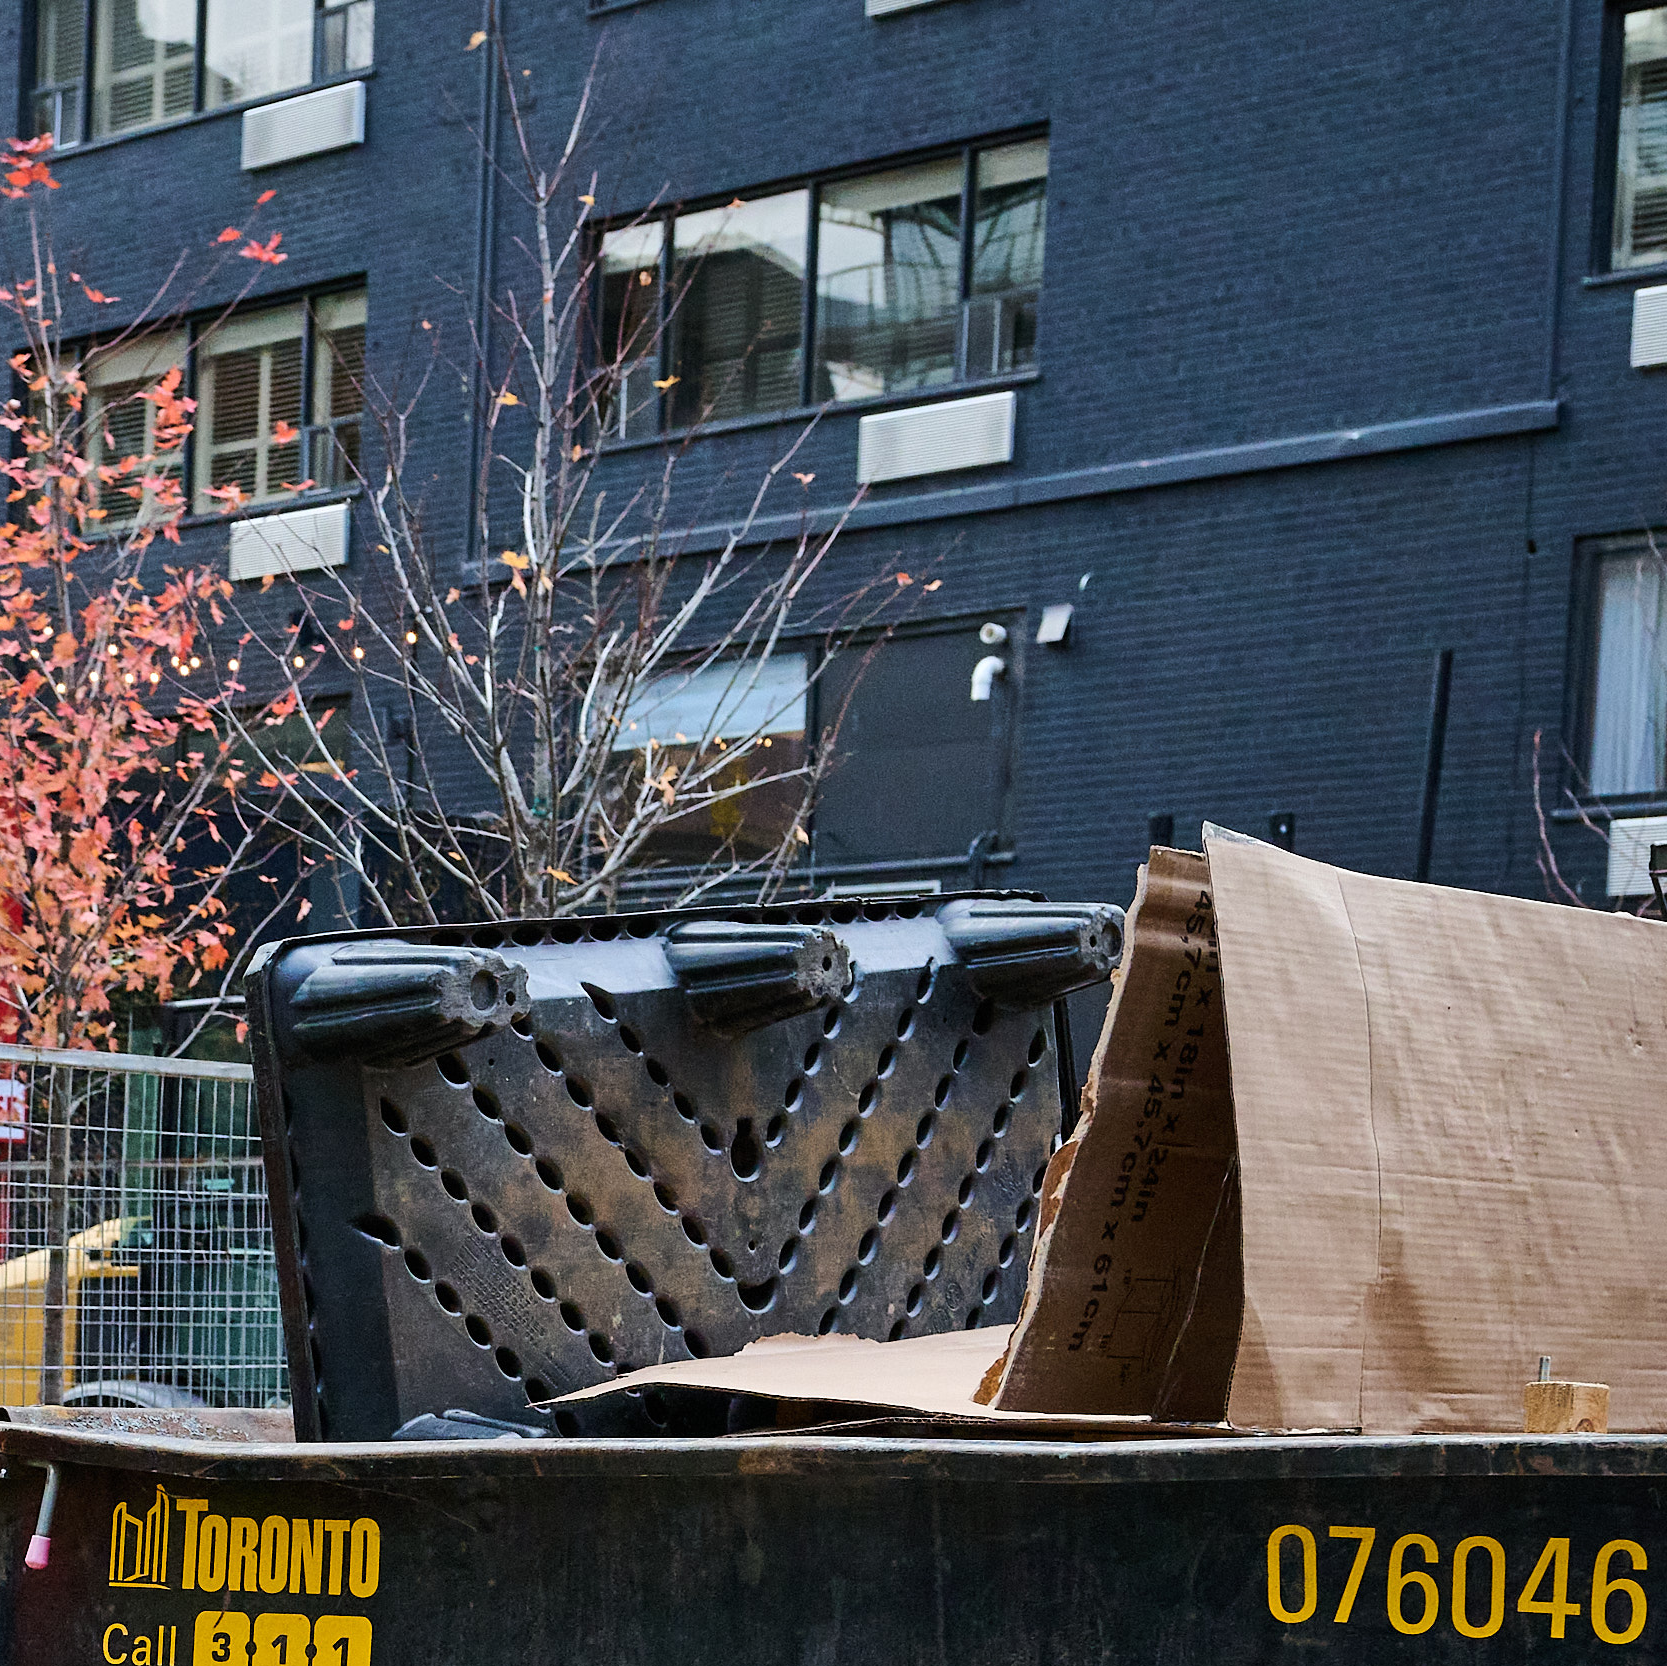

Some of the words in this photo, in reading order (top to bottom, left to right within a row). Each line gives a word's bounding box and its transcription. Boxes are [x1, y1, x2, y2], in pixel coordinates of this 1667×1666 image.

[1067, 1252, 1110, 1352] 61cm
[176, 1499, 381, 1598] TORONTO
[1267, 1524, 1648, 1645] 076046
